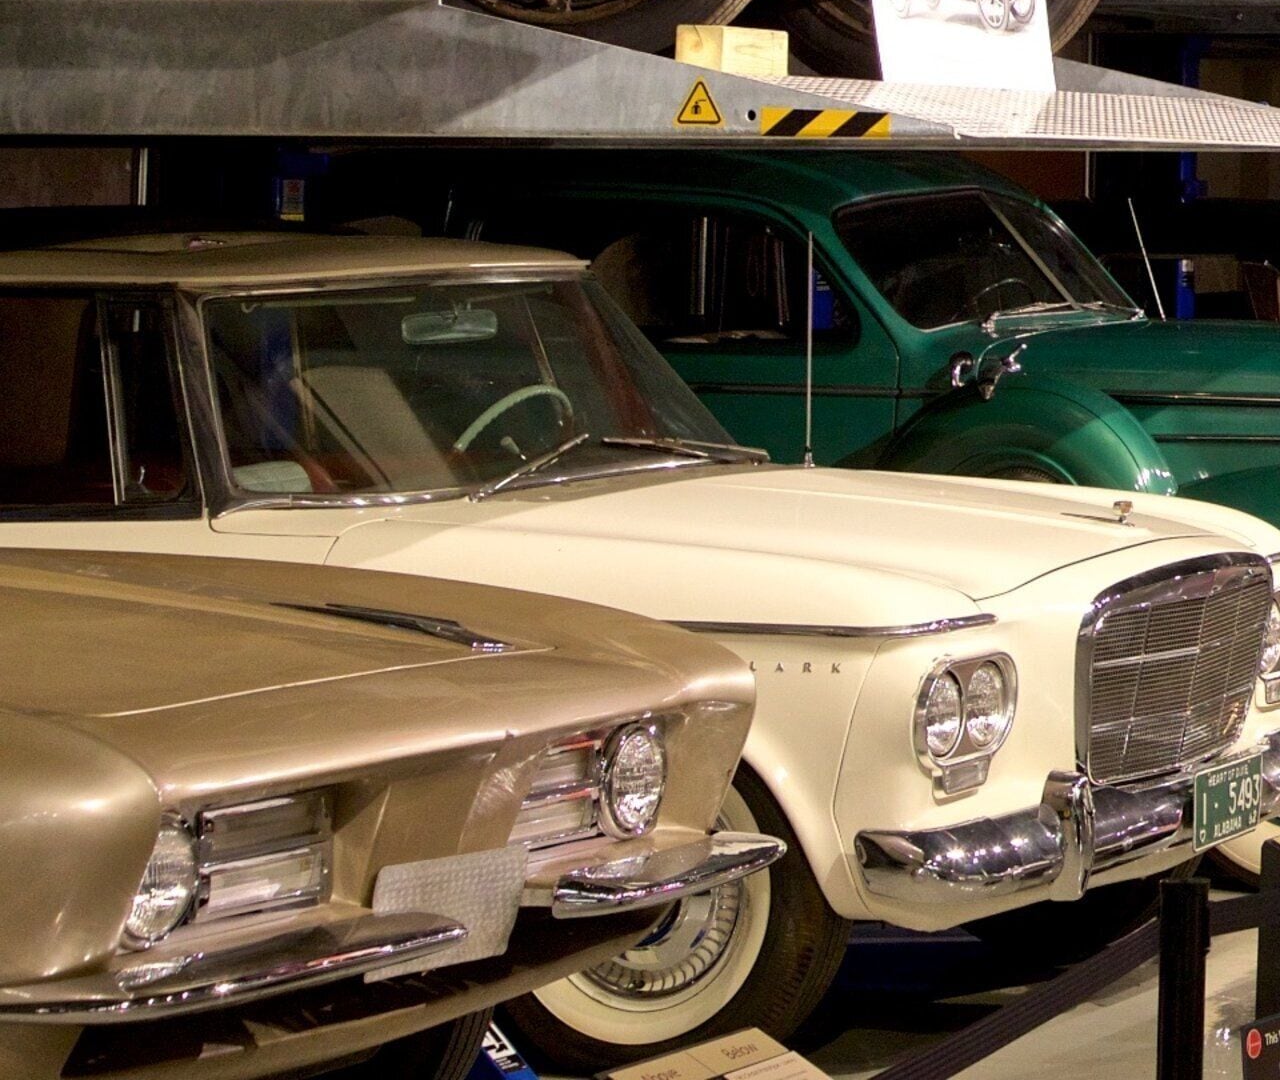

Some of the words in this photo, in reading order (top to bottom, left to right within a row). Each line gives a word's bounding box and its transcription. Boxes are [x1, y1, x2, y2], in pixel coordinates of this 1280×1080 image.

[749, 661, 841, 673] LARK
[1213, 816, 1242, 838] ALABAMA
[1265, 1031, 1278, 1046] This
